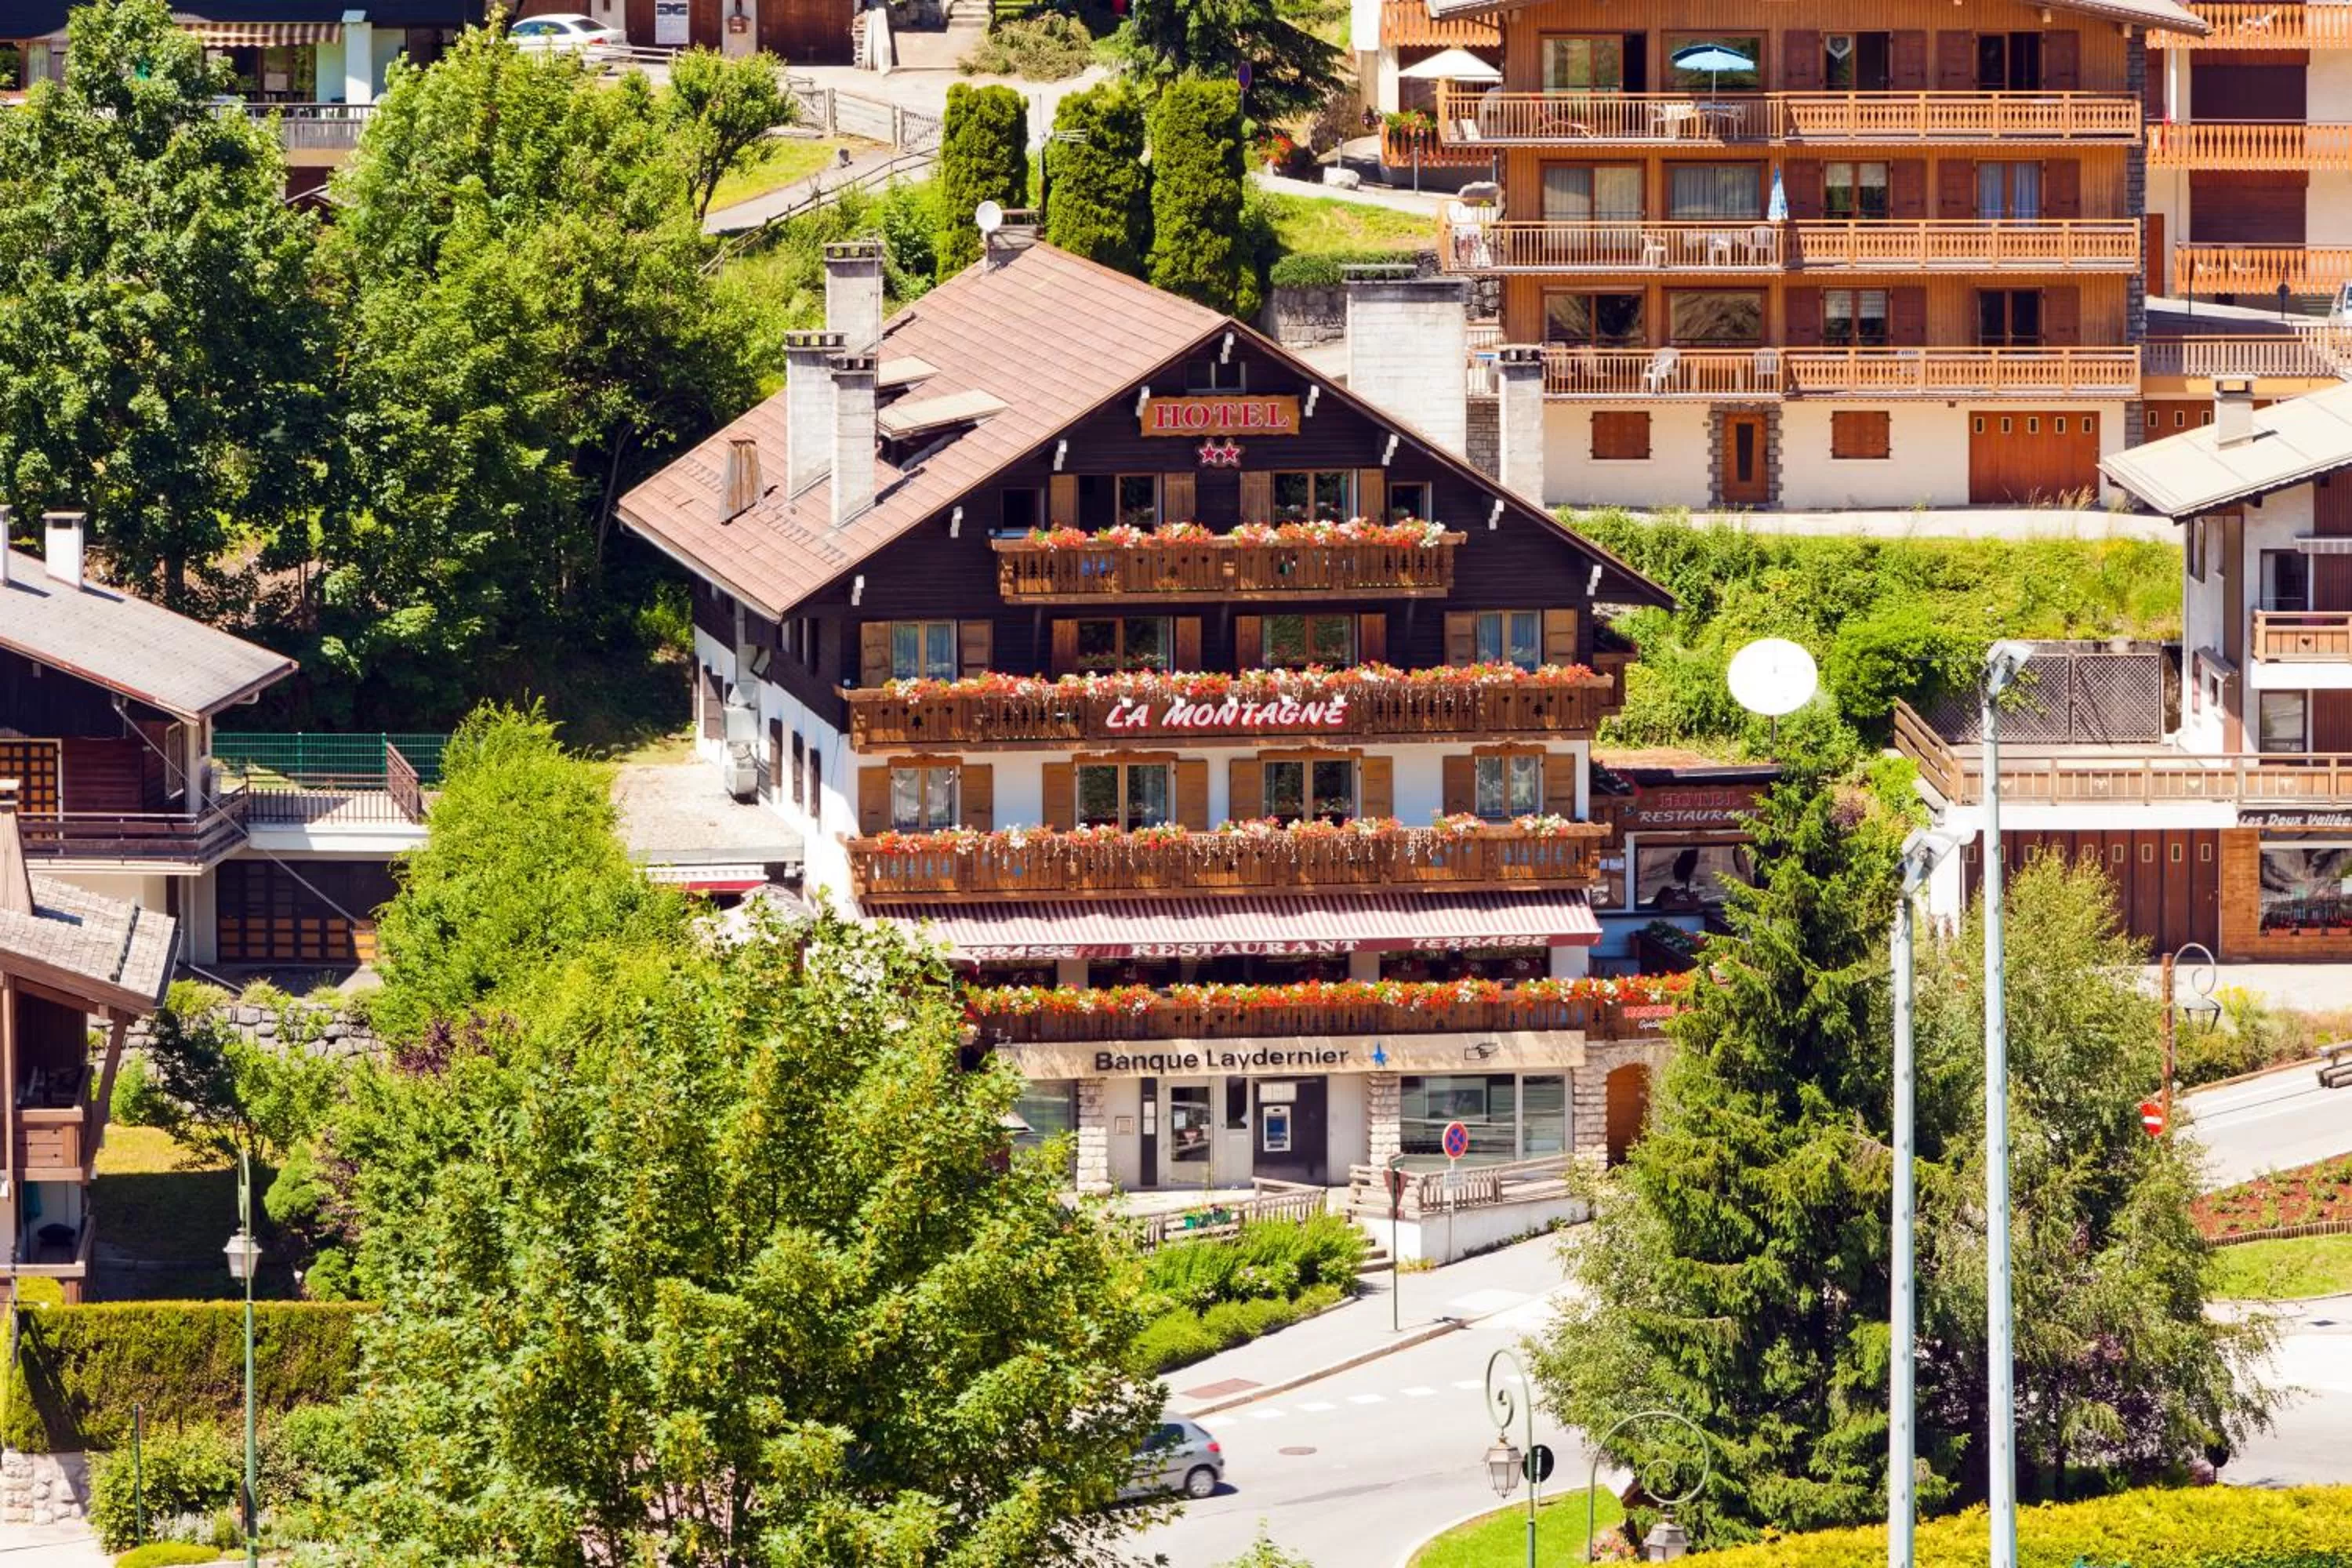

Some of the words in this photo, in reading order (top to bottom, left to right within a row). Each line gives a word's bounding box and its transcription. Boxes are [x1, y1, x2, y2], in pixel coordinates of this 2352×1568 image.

[1152, 402, 1290, 429] HOTEL
[1105, 704, 1151, 730] LA
[1161, 701, 1348, 730] MONTAGNE
[1658, 791, 1740, 808] HOTEL
[2239, 815, 2264, 826] Les
[2267, 813, 2303, 826] Deux
[1130, 940, 1360, 957] RESTAURANT
[1412, 935, 1550, 949] TERRASSE
[1094, 1051, 1199, 1074] Banque
[1206, 1047, 1349, 1071] Laydernier
